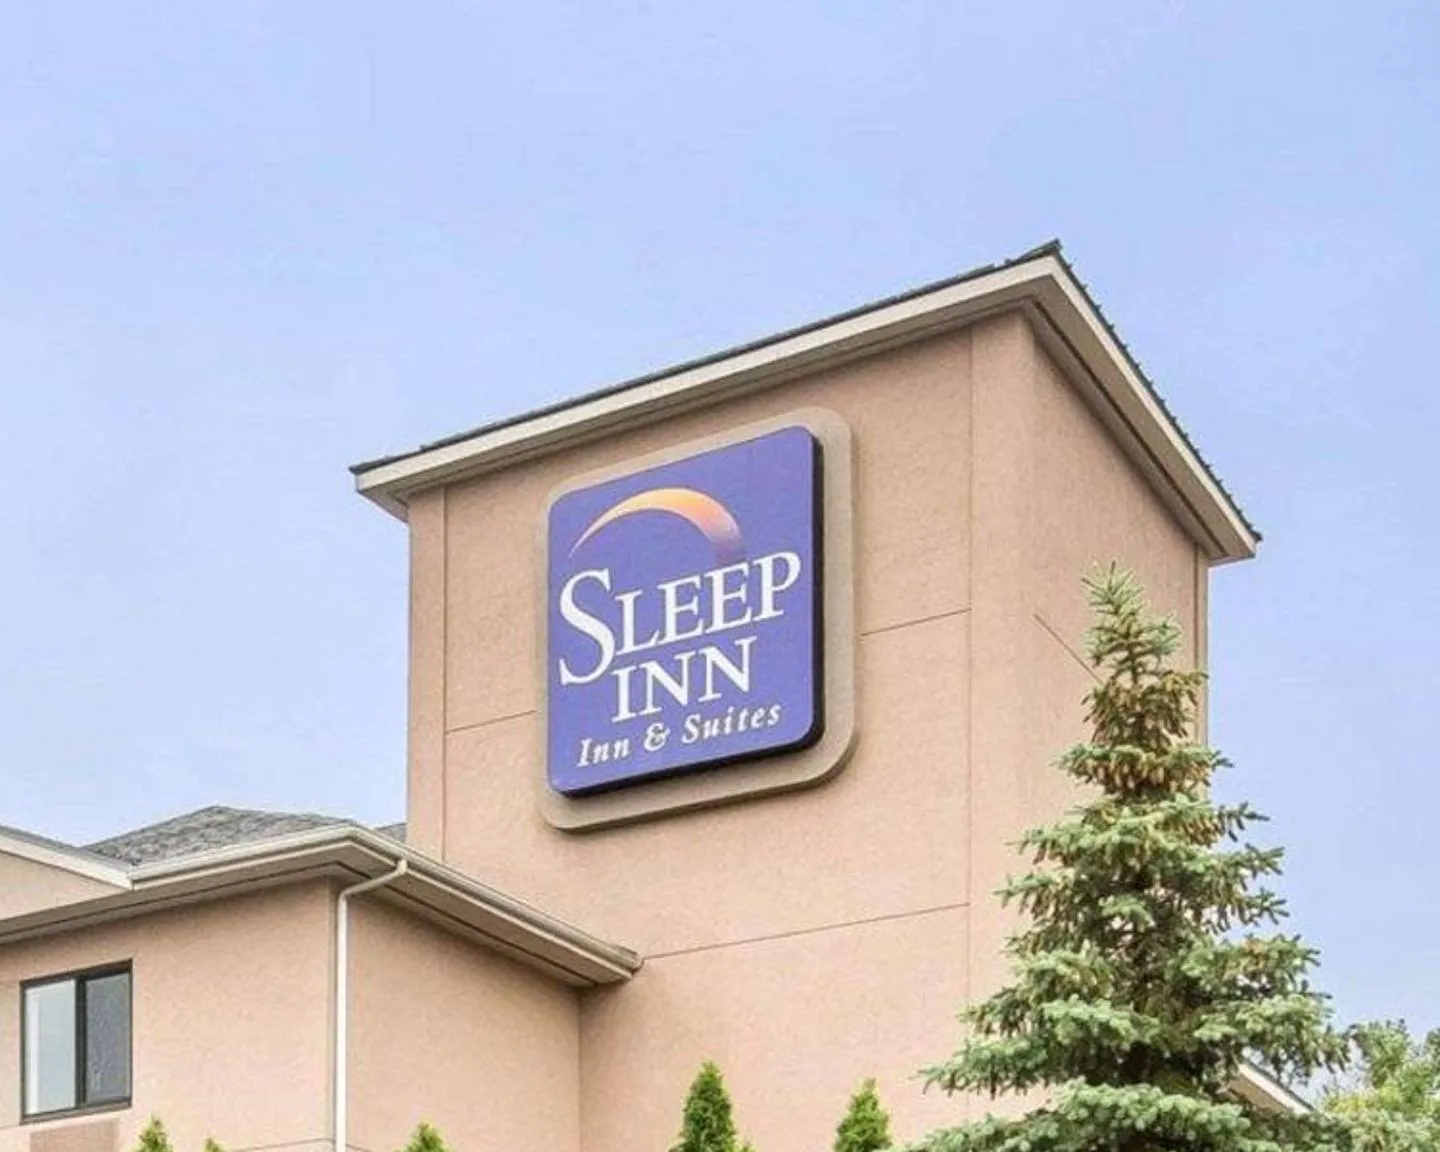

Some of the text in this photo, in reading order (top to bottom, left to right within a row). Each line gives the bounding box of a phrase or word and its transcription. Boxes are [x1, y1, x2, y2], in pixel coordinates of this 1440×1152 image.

[559, 551, 801, 686] SLEEP
[611, 636, 757, 723] INN
[577, 702, 782, 768] Inn & Suites
